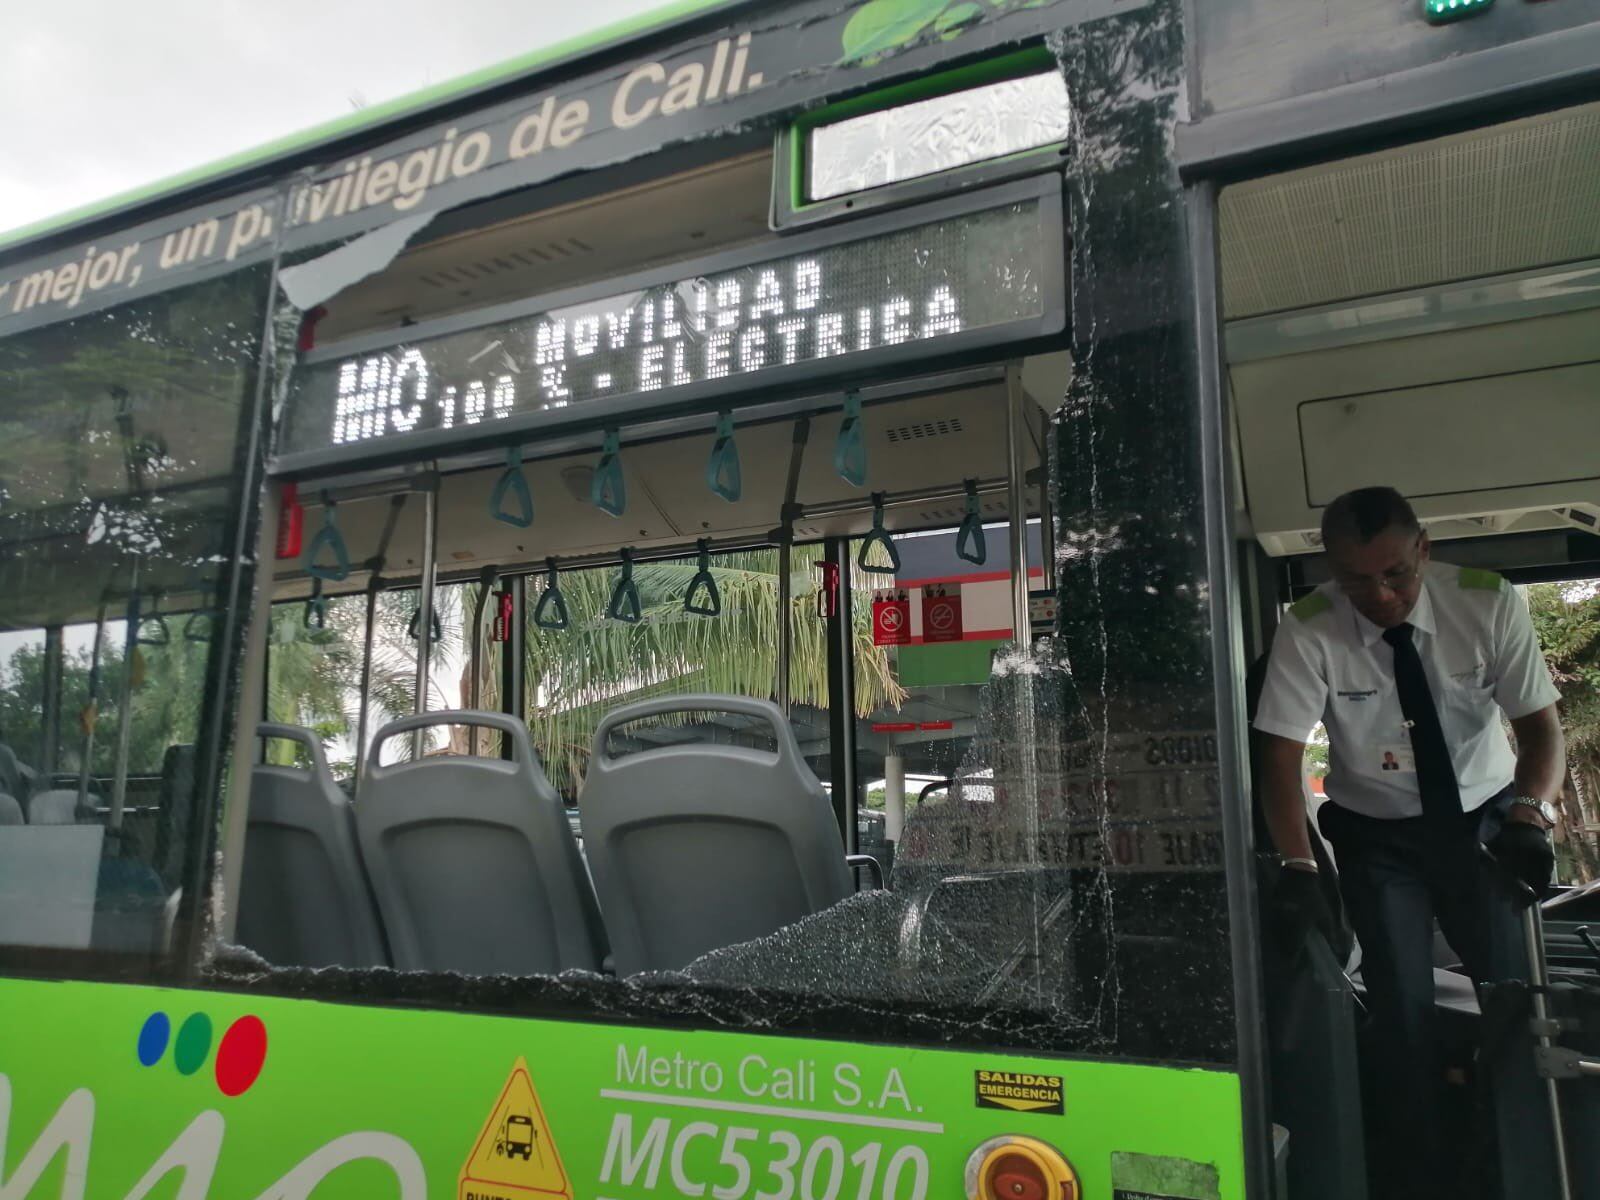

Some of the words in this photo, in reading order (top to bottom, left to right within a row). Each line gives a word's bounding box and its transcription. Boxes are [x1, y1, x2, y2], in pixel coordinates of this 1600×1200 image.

[13, 242, 142, 313] mejor,
[160, 217, 219, 269] un
[509, 95, 589, 160] de
[611, 32, 763, 129] Cali.
[615, 1043, 723, 1093] Metro
[738, 1054, 815, 1102] Cali
[833, 1062, 923, 1113] S.A.
[979, 1071, 1060, 1088] SALIDAS
[979, 1084, 1061, 1101] EMERGENCIA
[599, 1112, 930, 1200] MC53010
